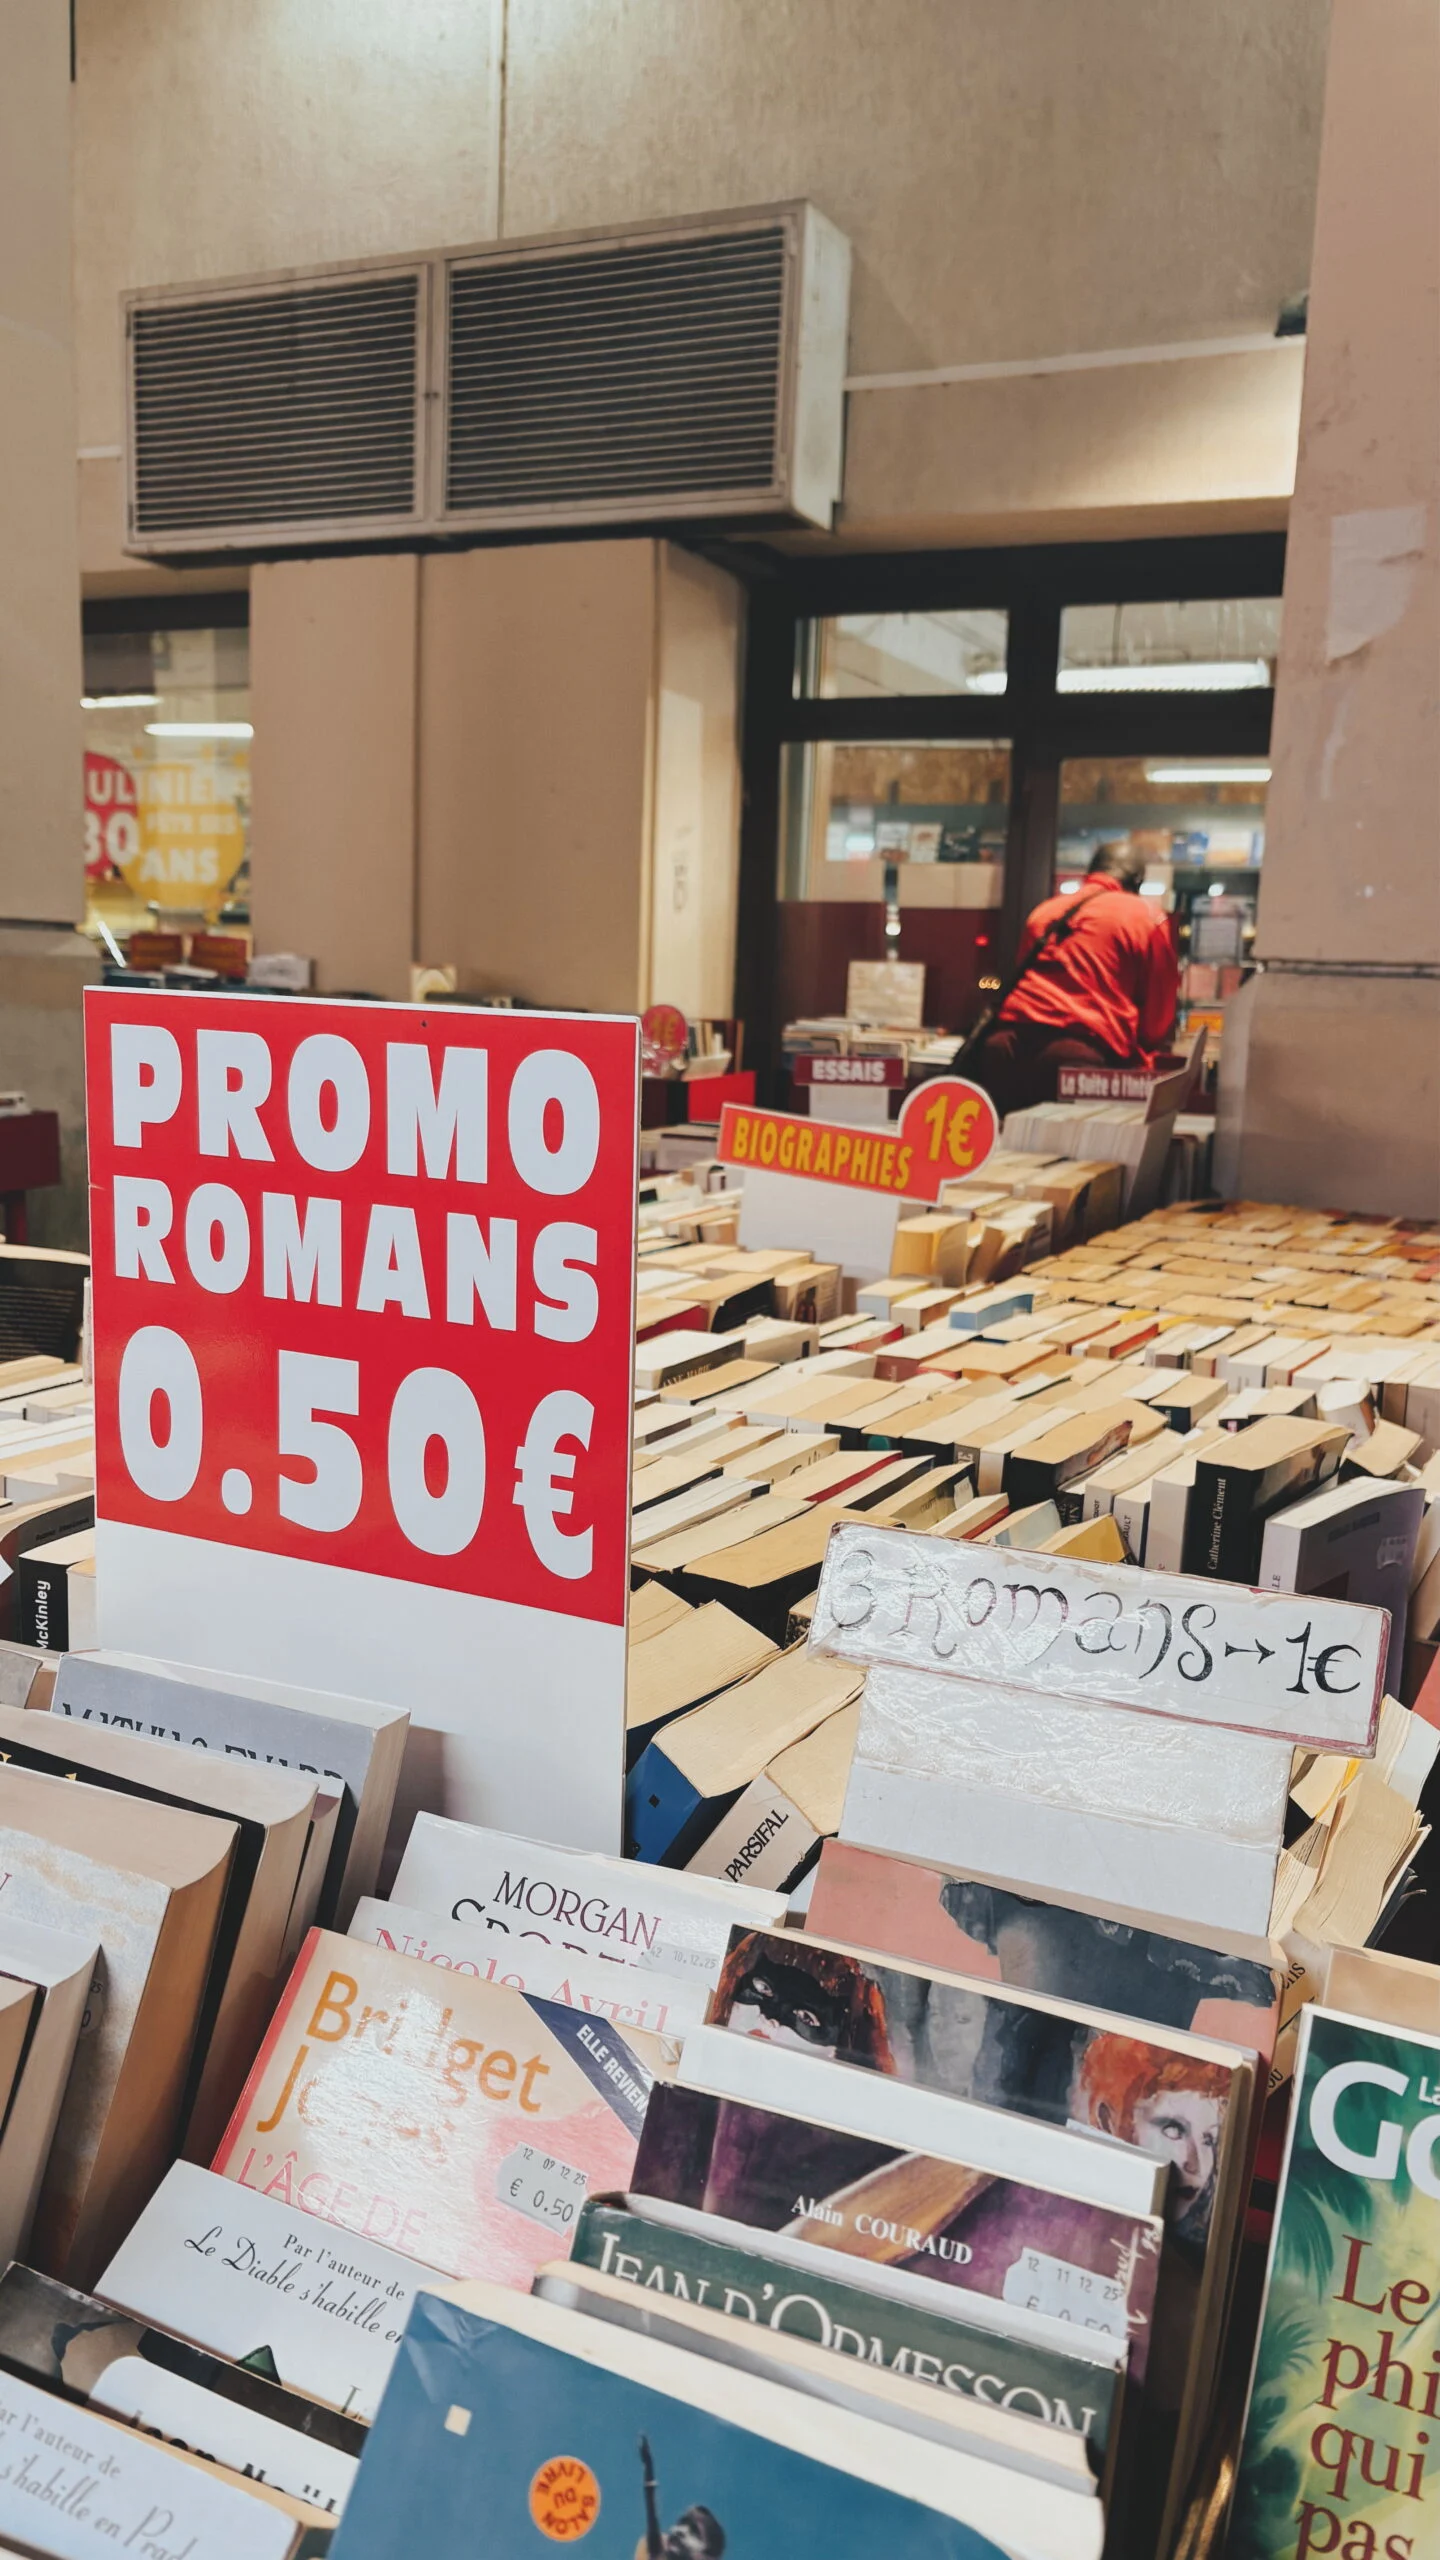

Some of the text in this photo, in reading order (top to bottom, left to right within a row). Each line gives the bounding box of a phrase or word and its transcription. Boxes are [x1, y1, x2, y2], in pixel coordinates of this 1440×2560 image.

[138, 846, 220, 884] ANS
[811, 1059, 886, 1083] ESSAIS
[110, 1023, 601, 1196] PROMO
[732, 1094, 982, 1190] BIOGRAPHIES 1€
[112, 1174, 600, 1343] ROMANS
[117, 1325, 596, 1580] 0.50€
[1206, 1476, 1228, 1571] Catherine Clément
[35, 1580, 52, 1650] McKinley
[830, 1548, 1362, 1695] 3 Romans 1€
[724, 1809, 790, 1883] PARSIFAL
[492, 1870, 662, 1950] MORGAN
[305, 1970, 550, 2113] Briget
[575, 2023, 651, 2118] ELLE REVIEN
[509, 2177, 574, 2223] € 0.50
[522, 2147, 535, 2161] 12
[559, 2165, 571, 2180] 12
[573, 2172, 588, 2187] 25
[282, 2232, 405, 2301] Par l'auteur de
[791, 2195, 973, 2265] Alain COURAUD
[183, 2225, 223, 2257] Le
[221, 2235, 303, 2294] Diable
[299, 2279, 388, 2334] s'habille
[600, 2231, 712, 2306] JEAN
[1027, 2256, 1040, 2273] 12
[1056, 2267, 1071, 2284] 11
[1079, 2275, 1093, 2294] 12
[1332, 2233, 1430, 2327] Le
[20, 2413, 96, 2465] l'auteur
[98, 2455, 122, 2480] de
[1310, 2422, 1430, 2502] qui
[94, 2515, 123, 2540] en
[1294, 2499, 1415, 2560] pas
